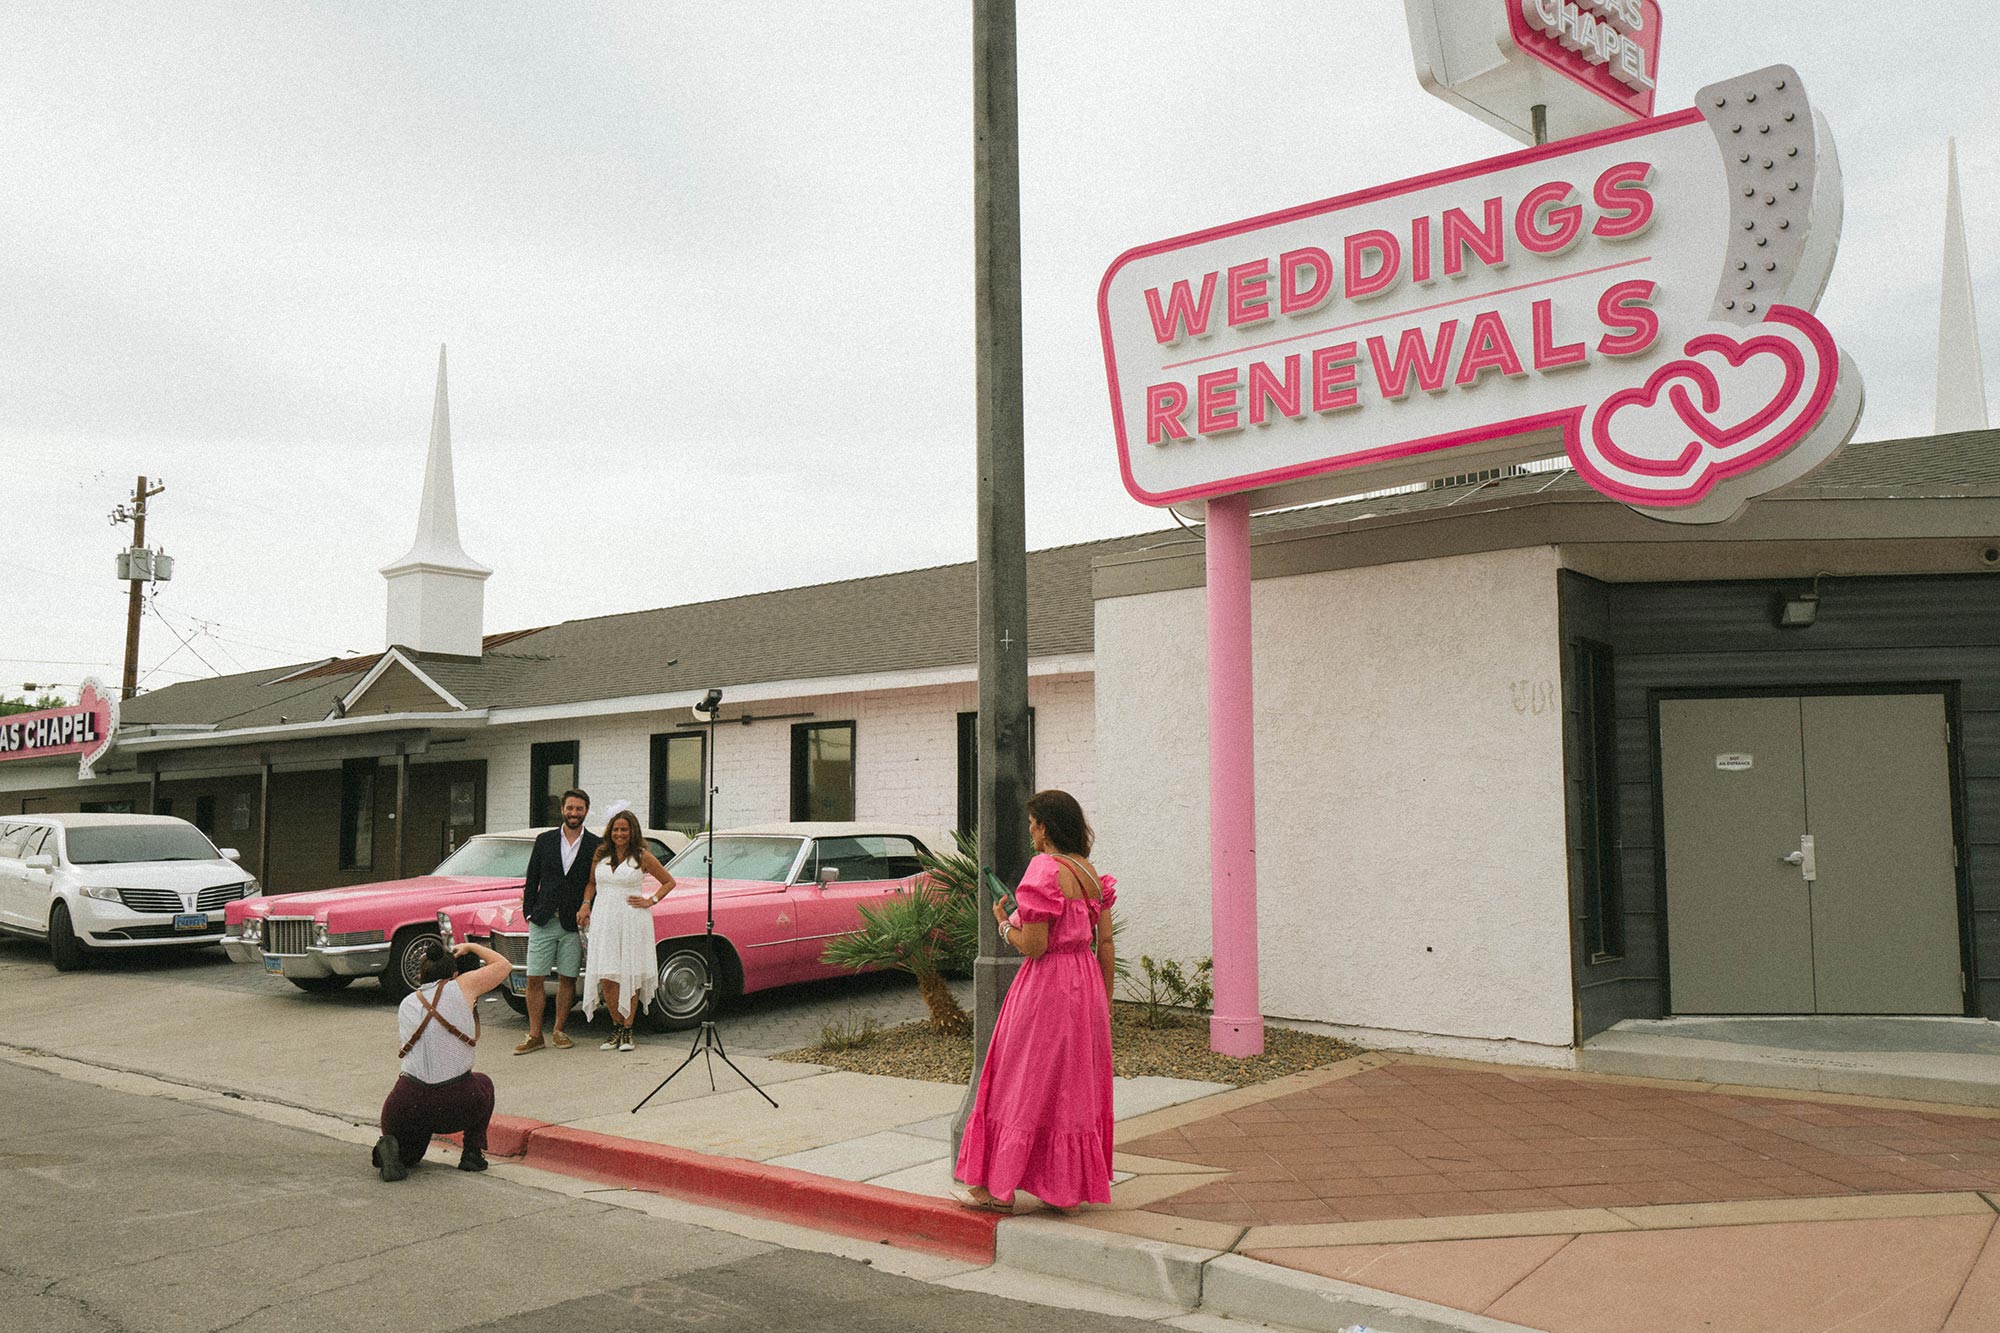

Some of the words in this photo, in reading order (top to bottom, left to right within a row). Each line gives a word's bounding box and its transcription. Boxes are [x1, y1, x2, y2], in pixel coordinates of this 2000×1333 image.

[1533, 0, 1655, 89] CHAPEL
[1143, 161, 1655, 346] WEDDINGS
[1146, 279, 1661, 445] RENEWALS
[25, 712, 94, 748] CHAPEL
